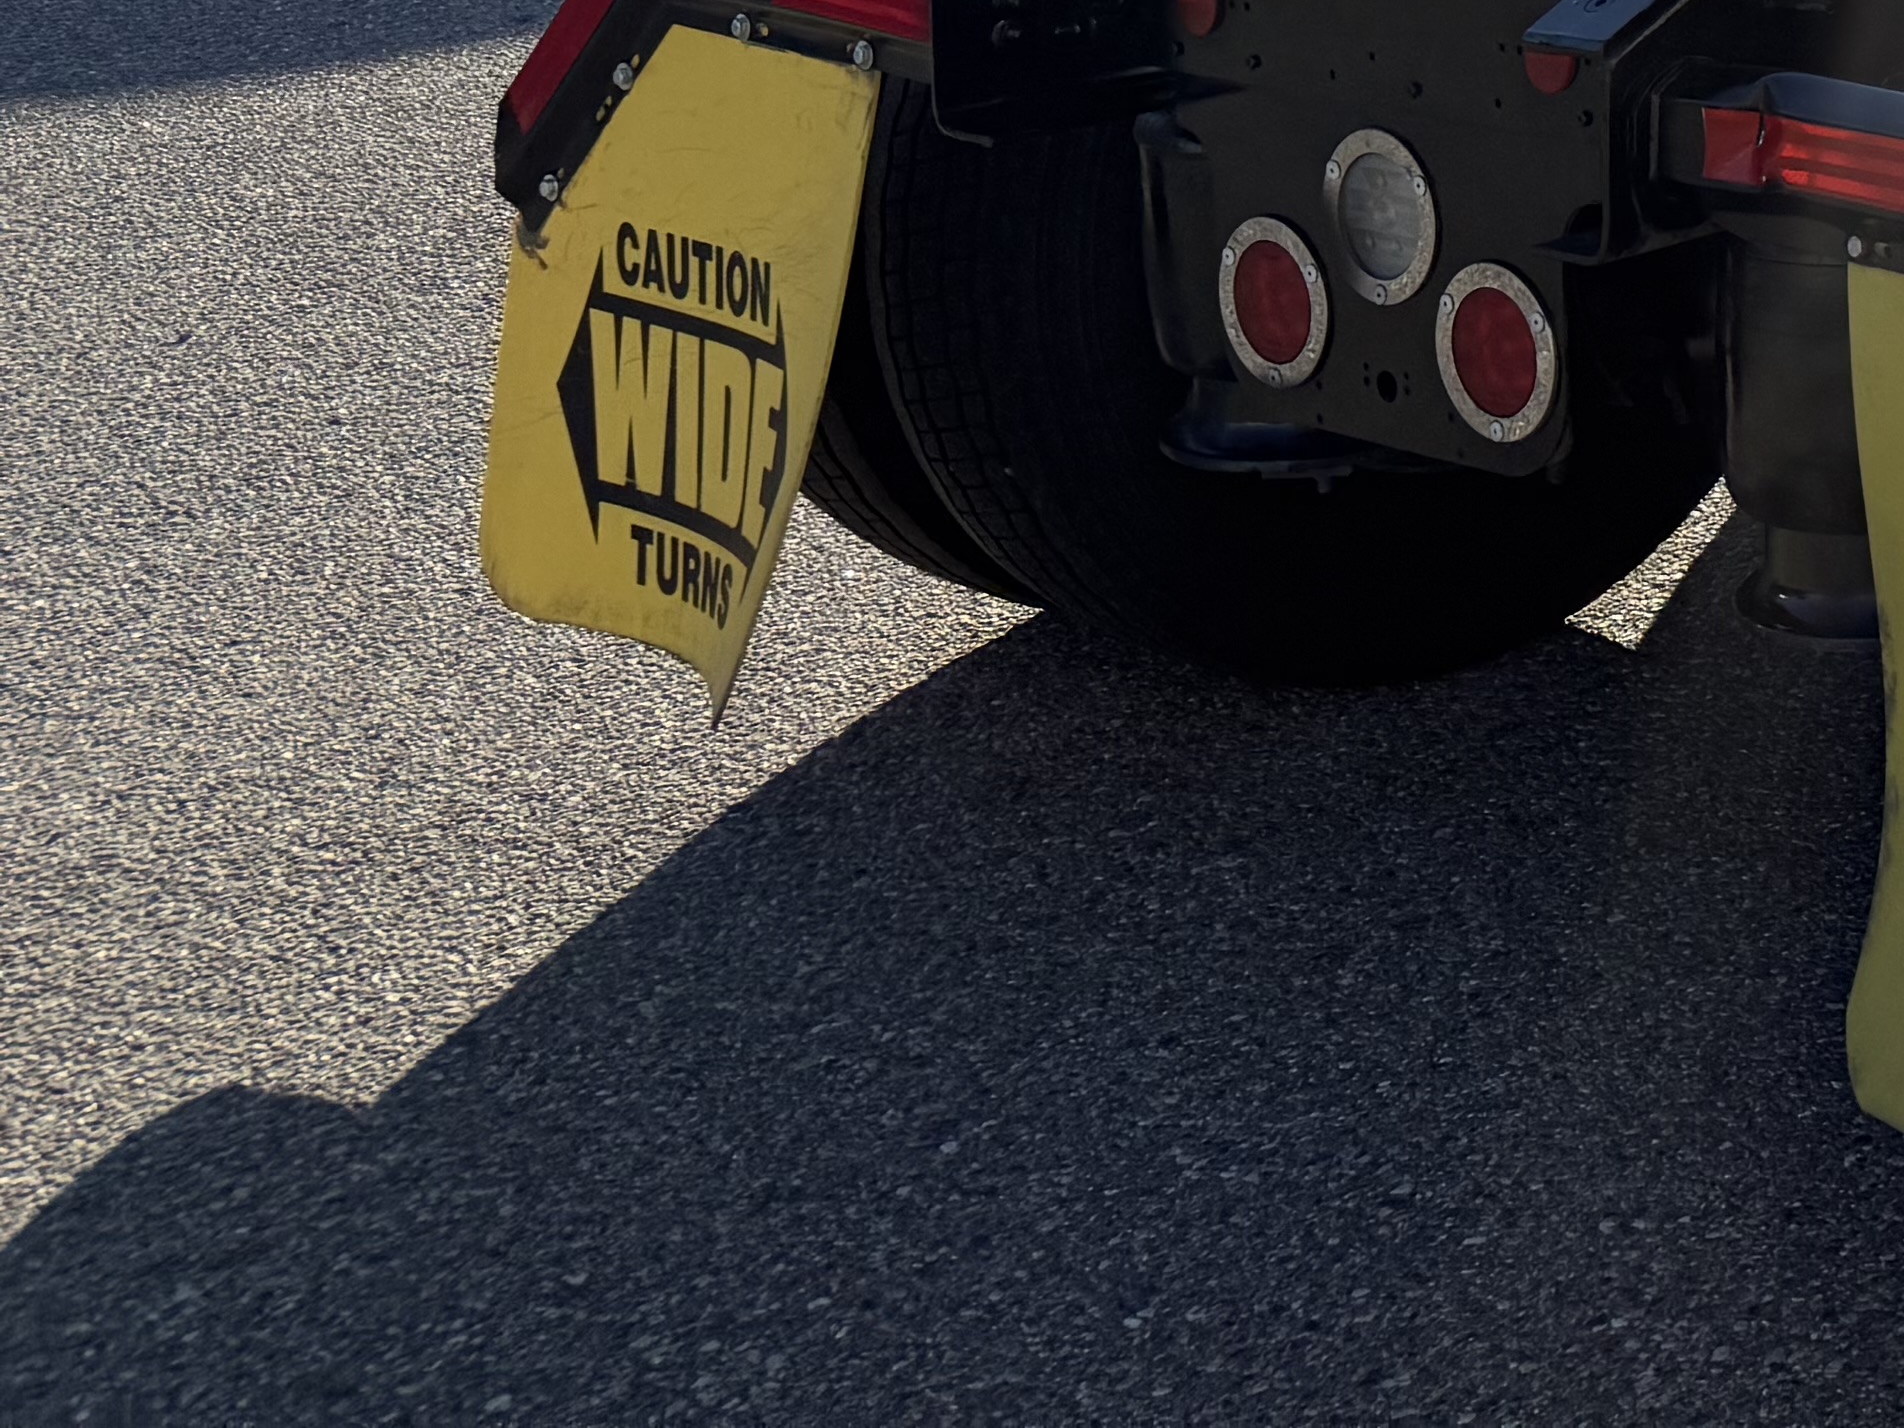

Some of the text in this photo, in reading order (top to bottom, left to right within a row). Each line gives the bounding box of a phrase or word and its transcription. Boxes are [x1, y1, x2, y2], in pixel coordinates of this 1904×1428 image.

[616, 221, 771, 327] CAUTION
[589, 307, 785, 551] WIDE
[630, 523, 734, 631] TURNS
